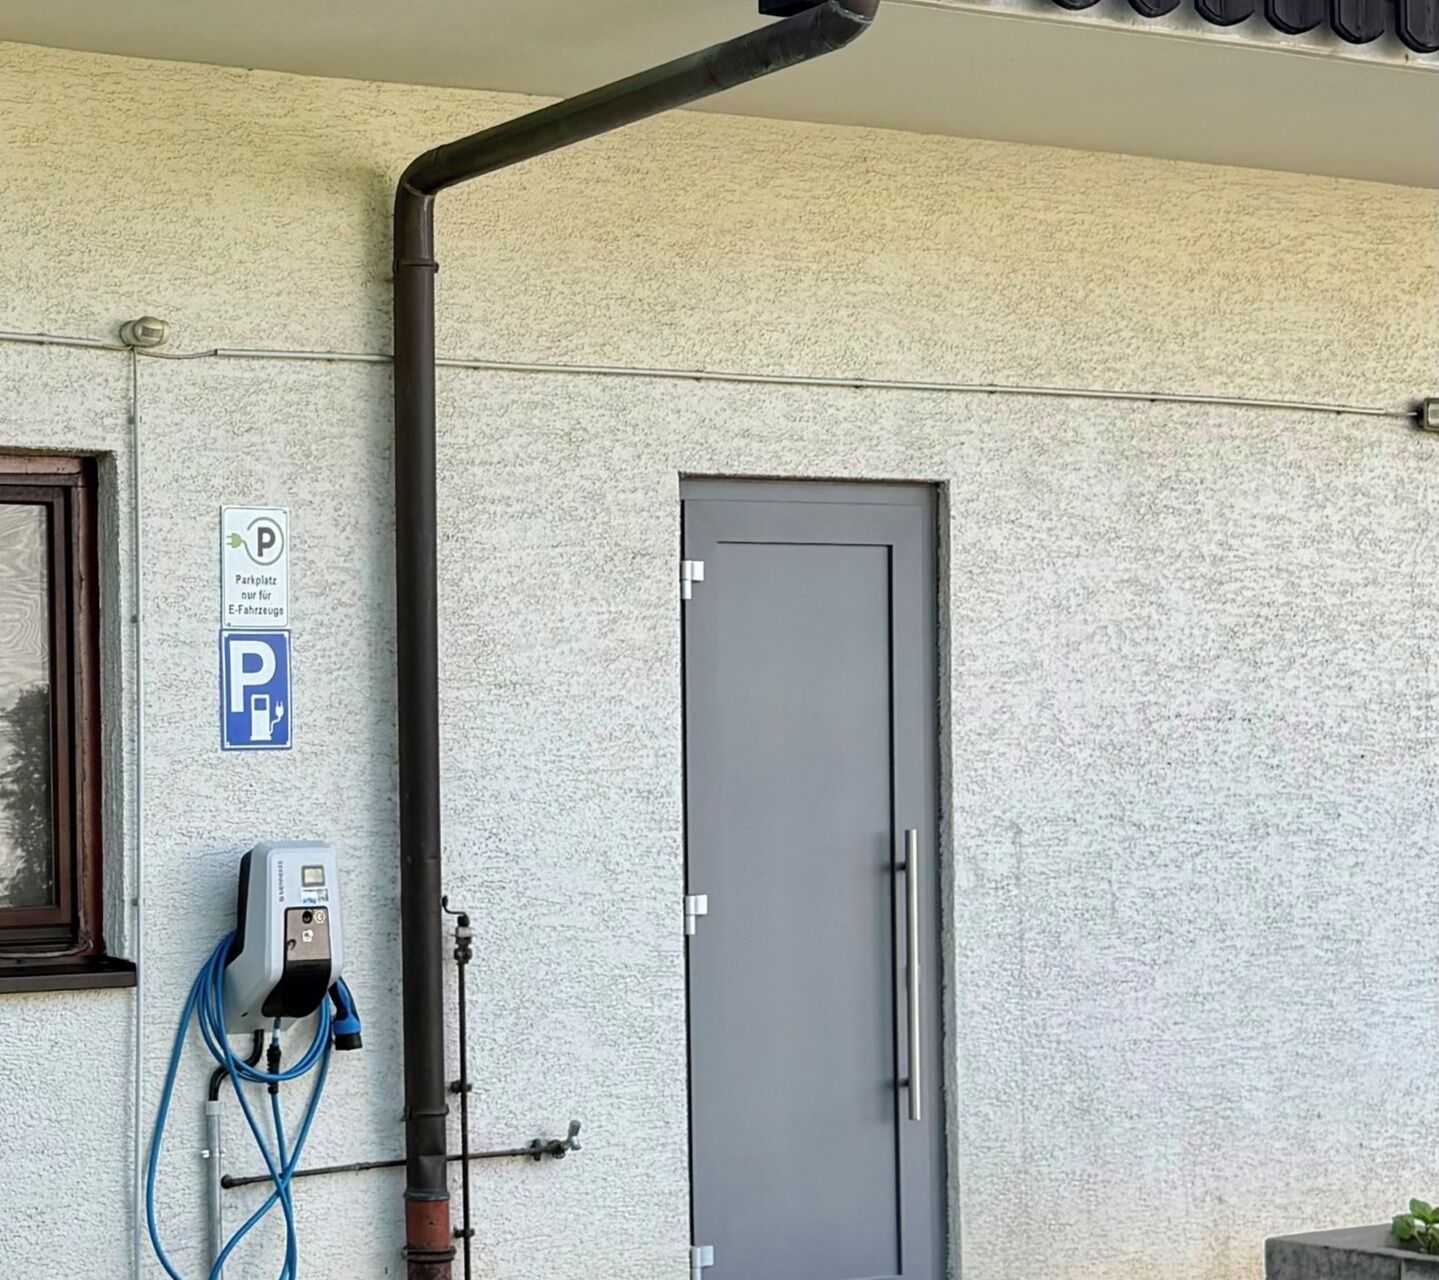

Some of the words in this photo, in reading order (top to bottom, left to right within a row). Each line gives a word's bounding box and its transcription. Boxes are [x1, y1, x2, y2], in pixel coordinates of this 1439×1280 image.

[257, 527, 276, 558] P
[235, 574, 277, 587] Parkplatz
[241, 592, 257, 600] nur
[258, 590, 271, 600] für
[228, 604, 284, 618] E-Fahrzeuge
[229, 640, 276, 713] P
